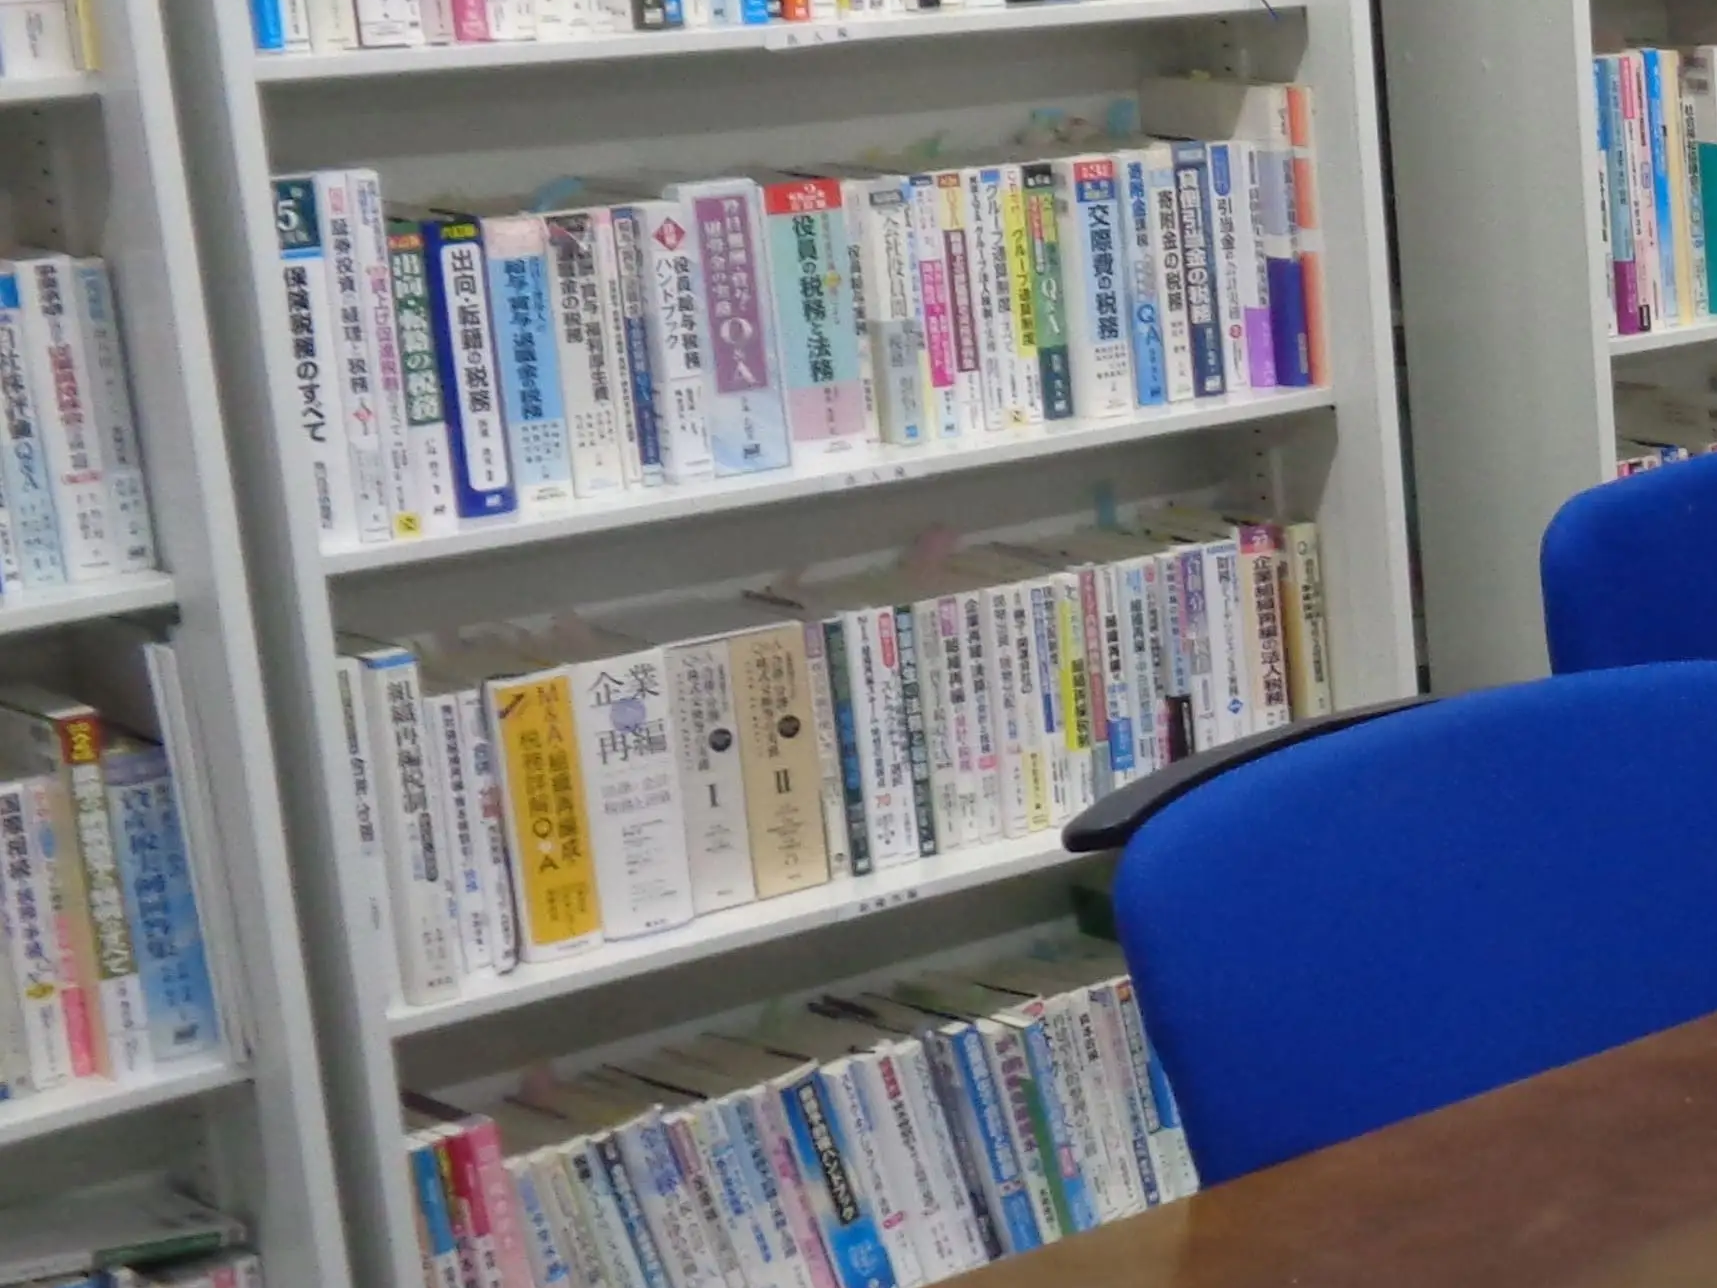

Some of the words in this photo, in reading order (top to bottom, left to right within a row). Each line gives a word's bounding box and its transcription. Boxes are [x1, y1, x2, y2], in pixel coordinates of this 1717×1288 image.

[656, 257, 680, 350] ハンドブック
[586, 661, 661, 710] 企業
